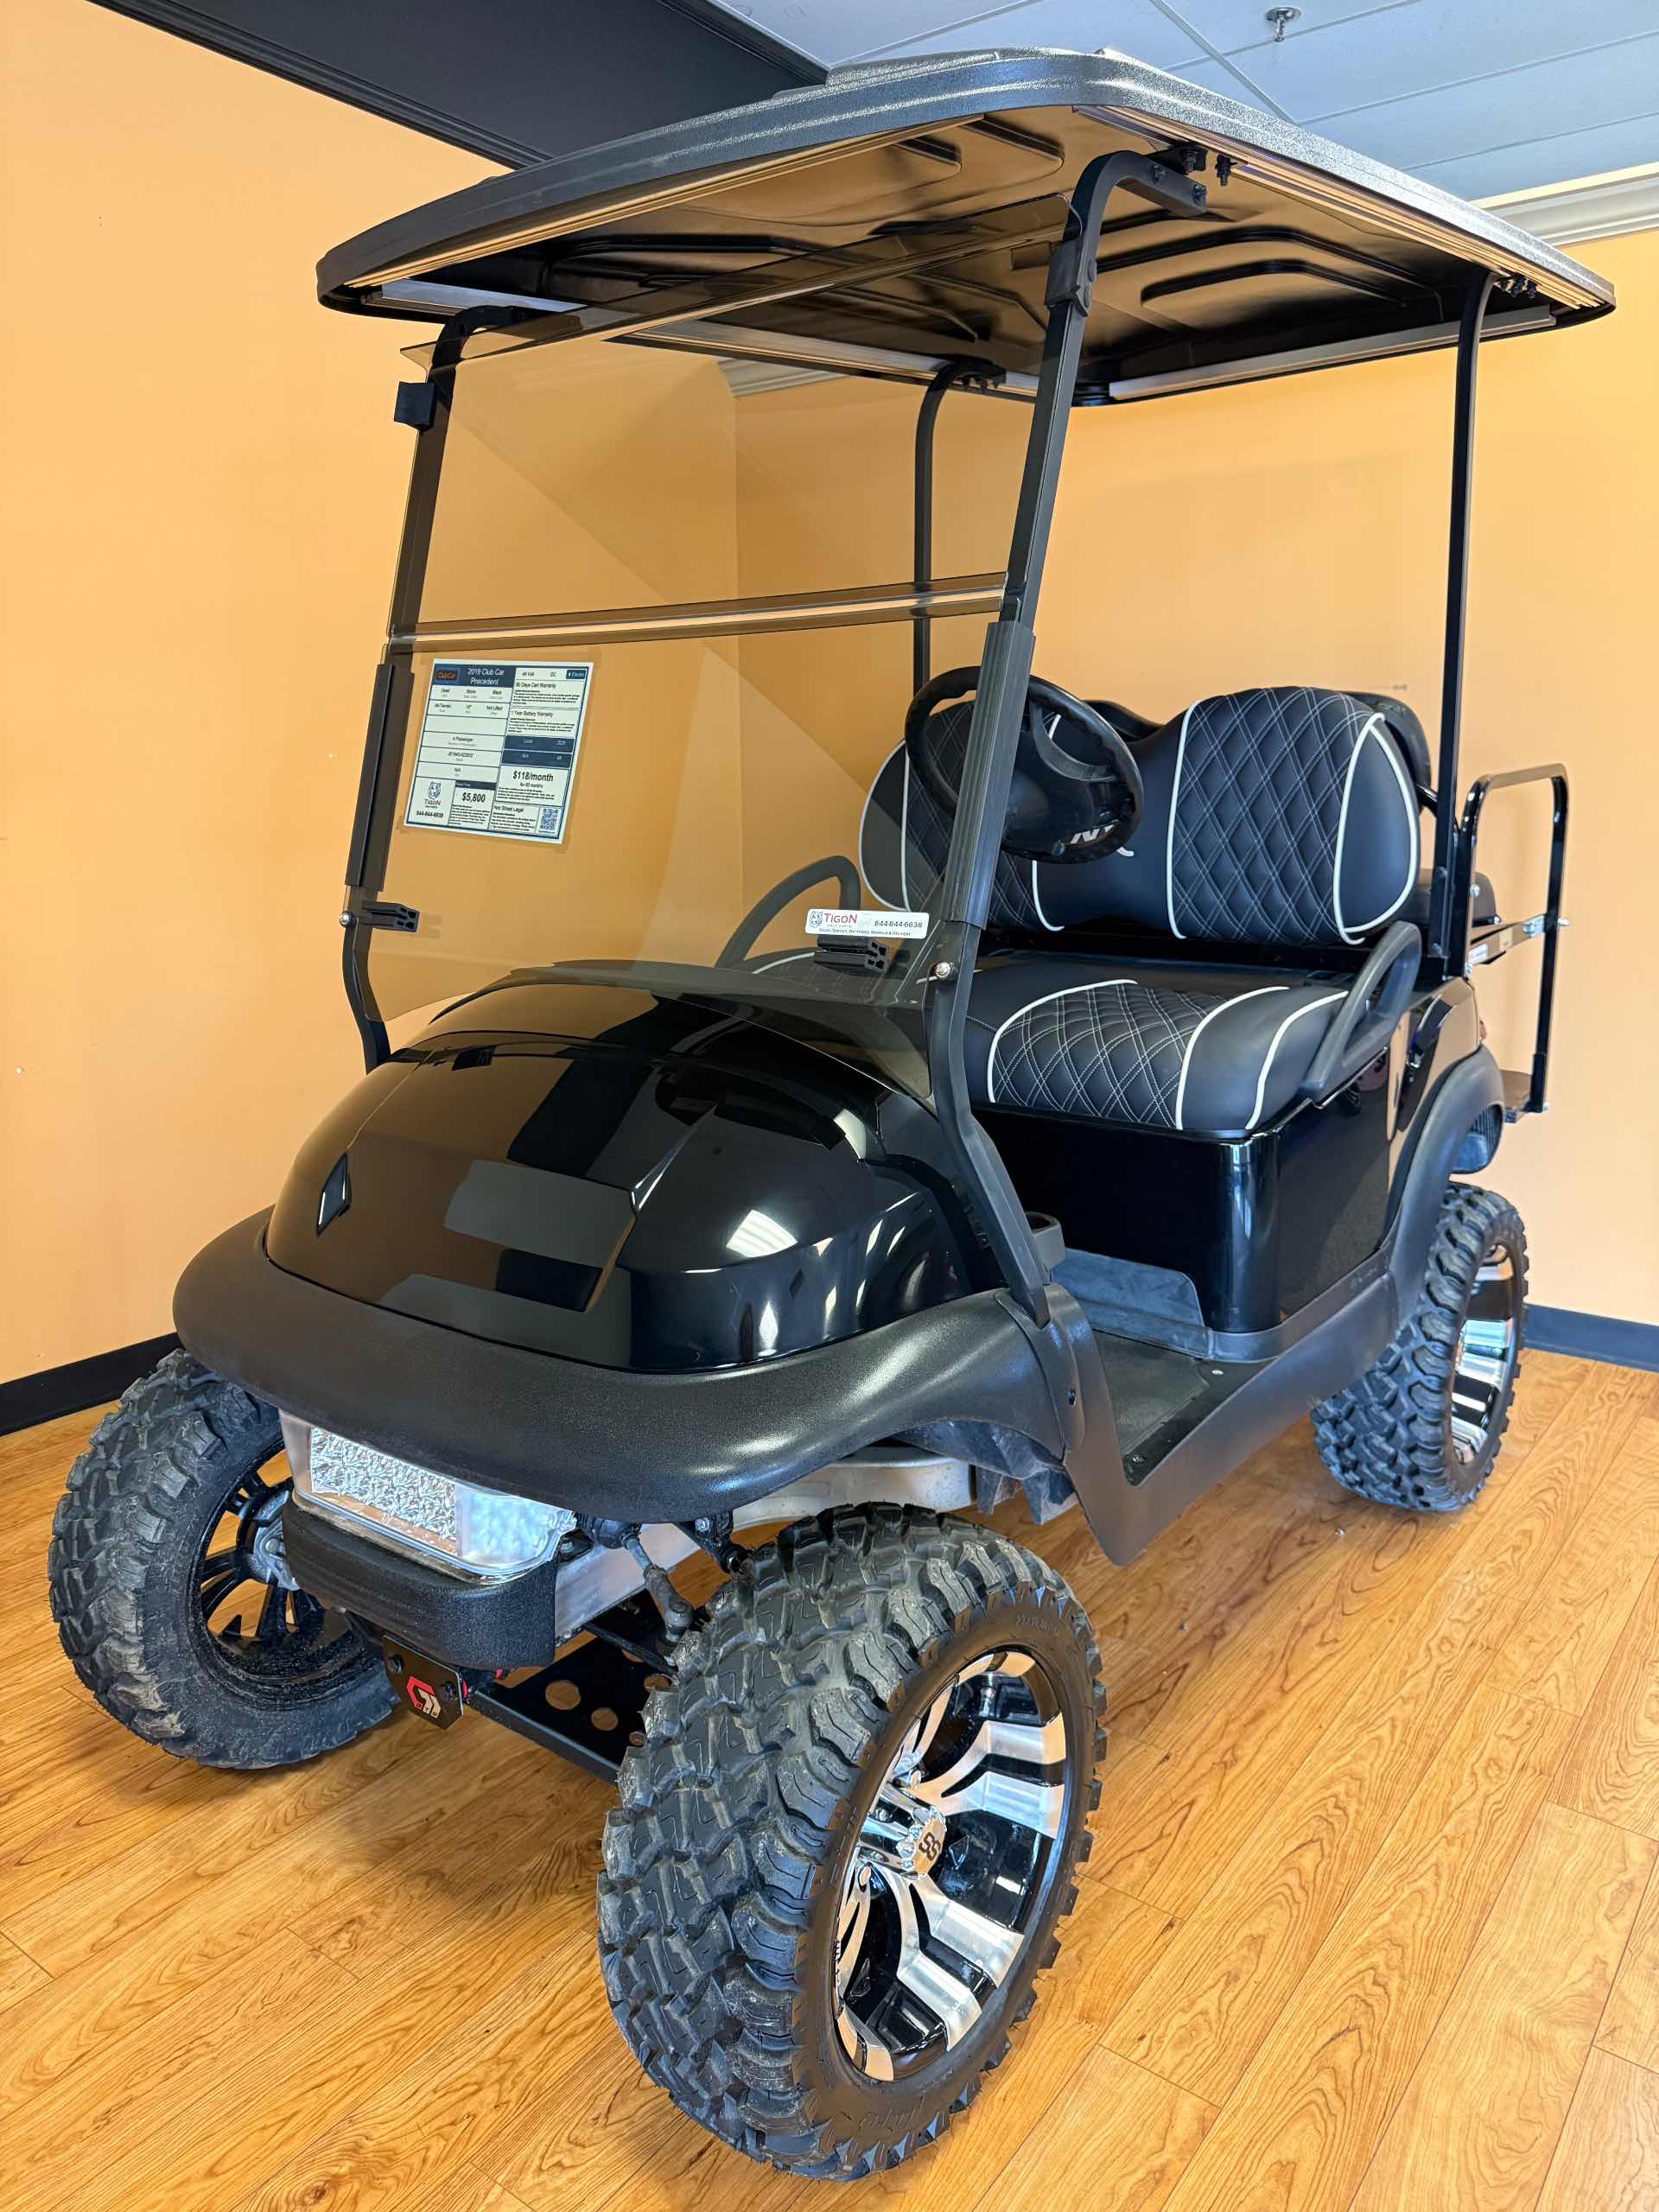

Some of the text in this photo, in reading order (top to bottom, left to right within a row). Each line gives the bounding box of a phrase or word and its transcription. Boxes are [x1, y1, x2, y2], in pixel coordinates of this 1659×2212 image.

[470, 677, 499, 685] Precedent
[512, 770, 554, 782] $118/month
[461, 791, 486, 803] $5,800
